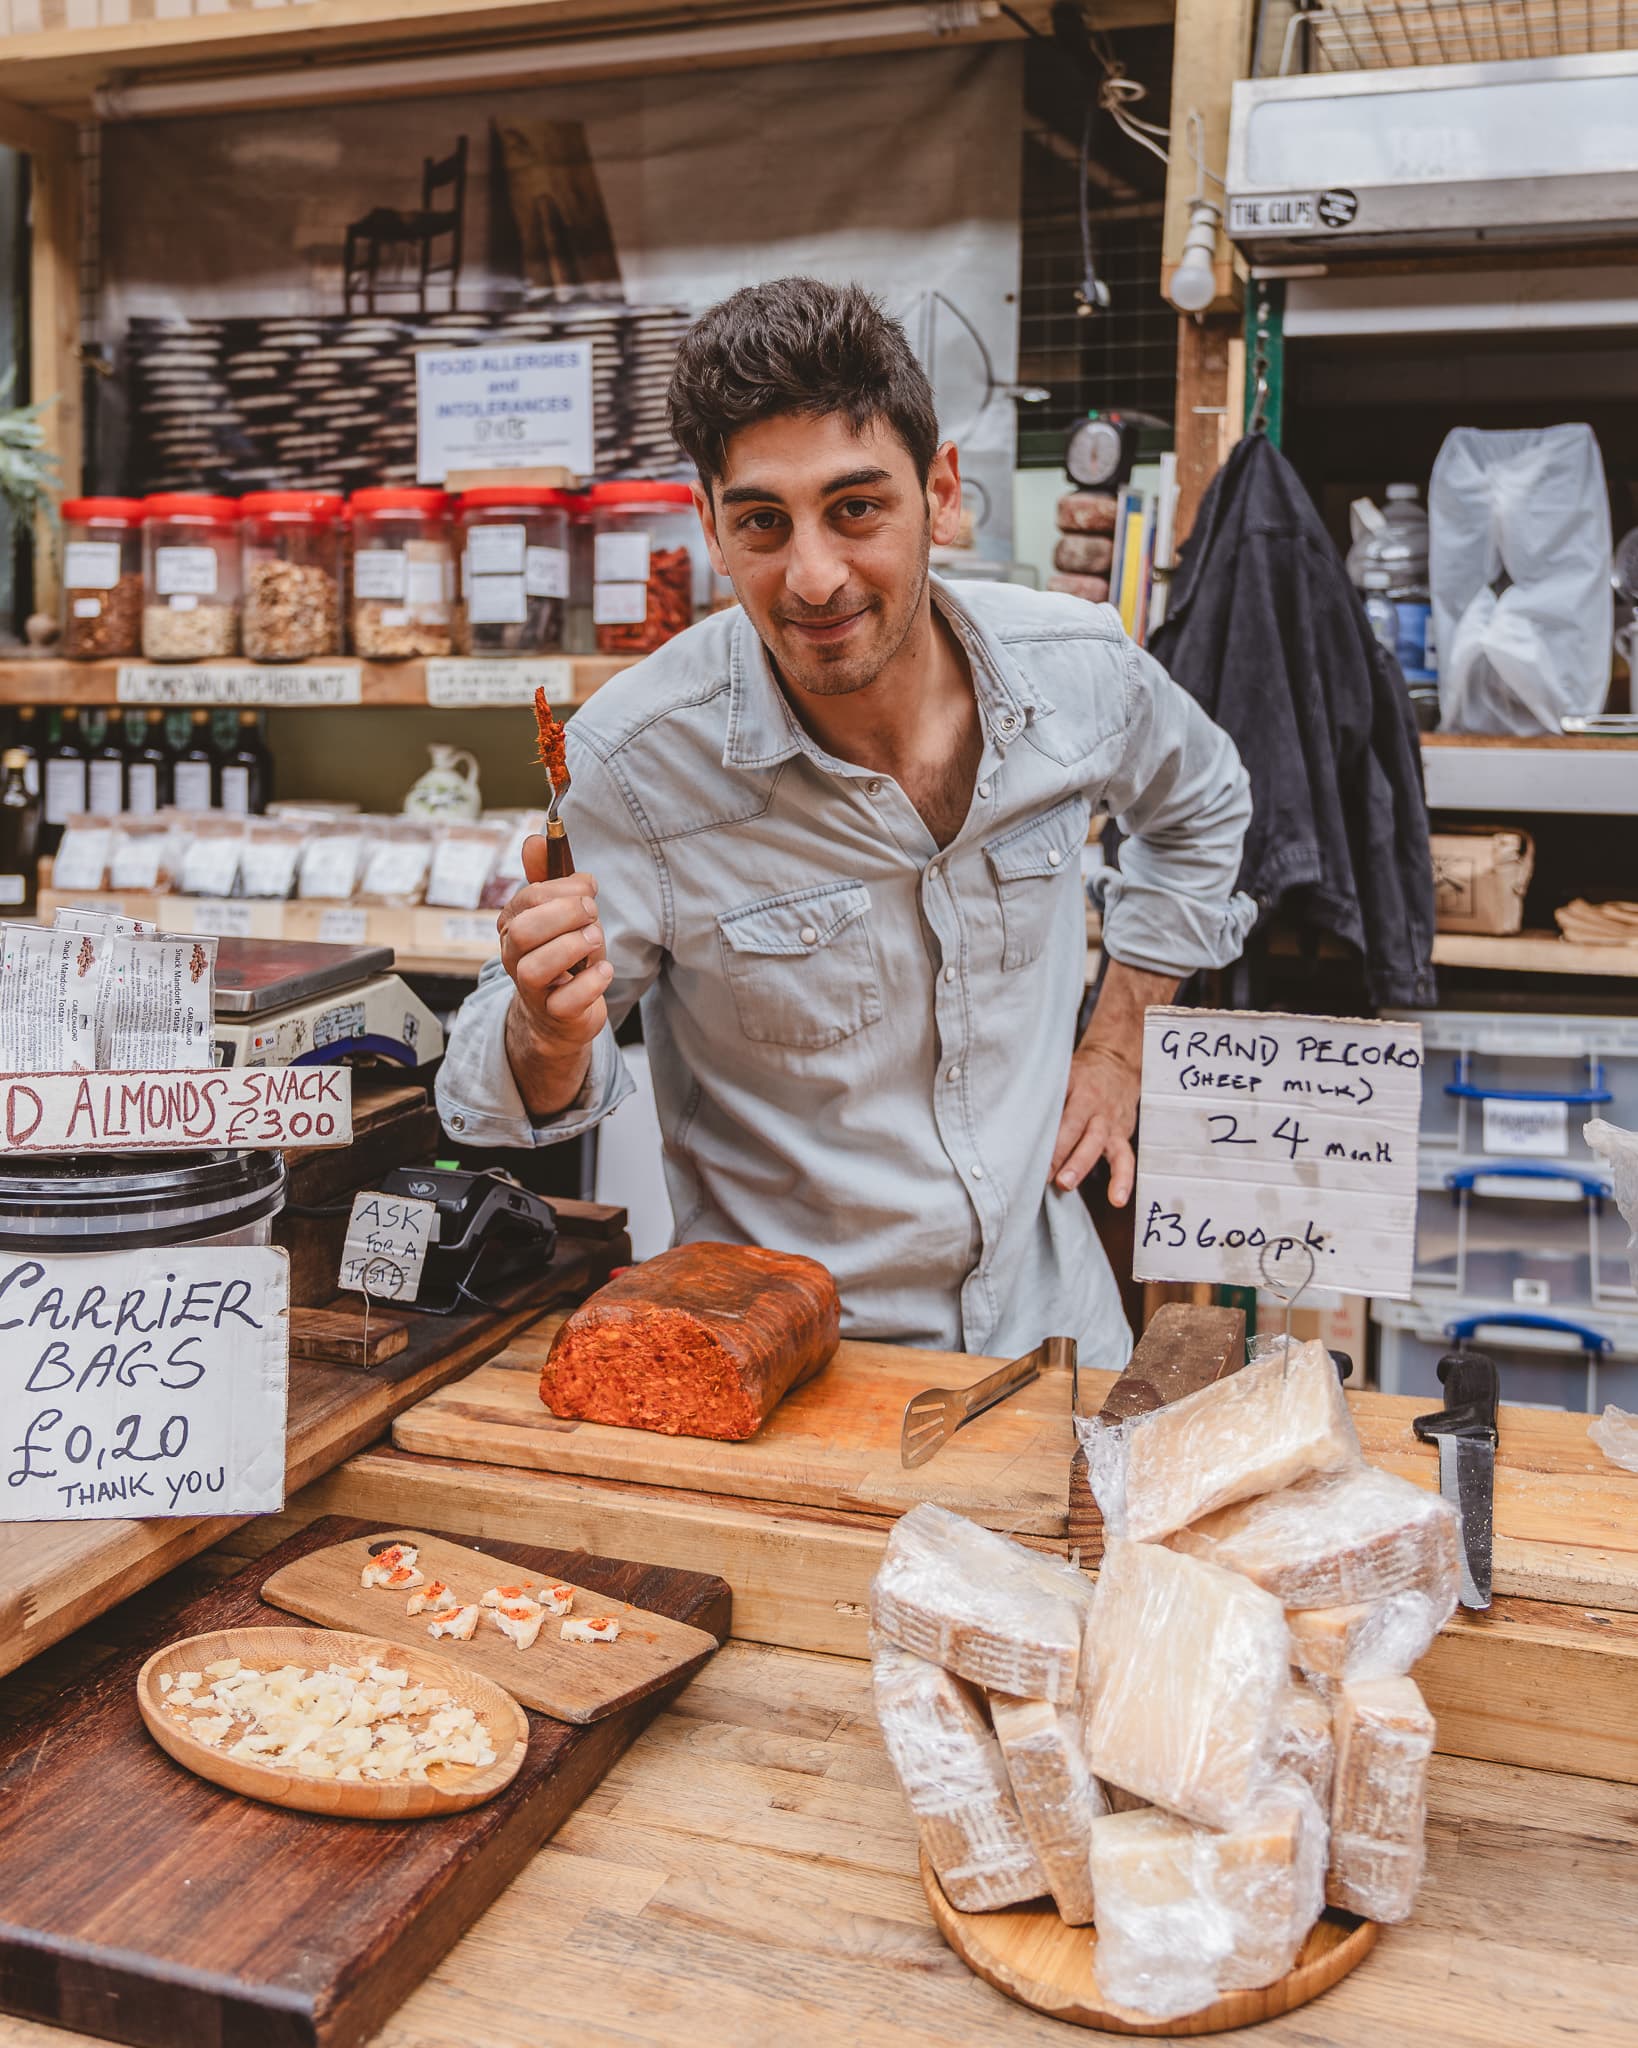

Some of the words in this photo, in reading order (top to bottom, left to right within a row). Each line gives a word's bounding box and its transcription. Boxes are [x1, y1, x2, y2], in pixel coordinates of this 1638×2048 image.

[1231, 203, 1263, 225] THE
[427, 358, 476, 375] FOOD
[480, 352, 580, 372] ALLERGIES
[488, 378, 520, 394] and
[436, 396, 573, 417] INTOLERANCES
[174, 948, 183, 968] Snack
[1161, 1030, 1279, 1067] GRAND
[1297, 1035, 1421, 1069] PECORO
[227, 1069, 343, 1107] SNACK
[1179, 1064, 1263, 1092] (SHEEP
[66, 1077, 228, 1138] ALMONDS
[355, 1200, 423, 1234] ASK
[365, 1231, 395, 1256] FOR
[401, 1241, 417, 1260] A
[25, 1336, 206, 1393] BAGS
[8, 1408, 189, 1488] £0,20
[57, 1472, 155, 1508] THANK
[166, 1466, 225, 1509] YOU
